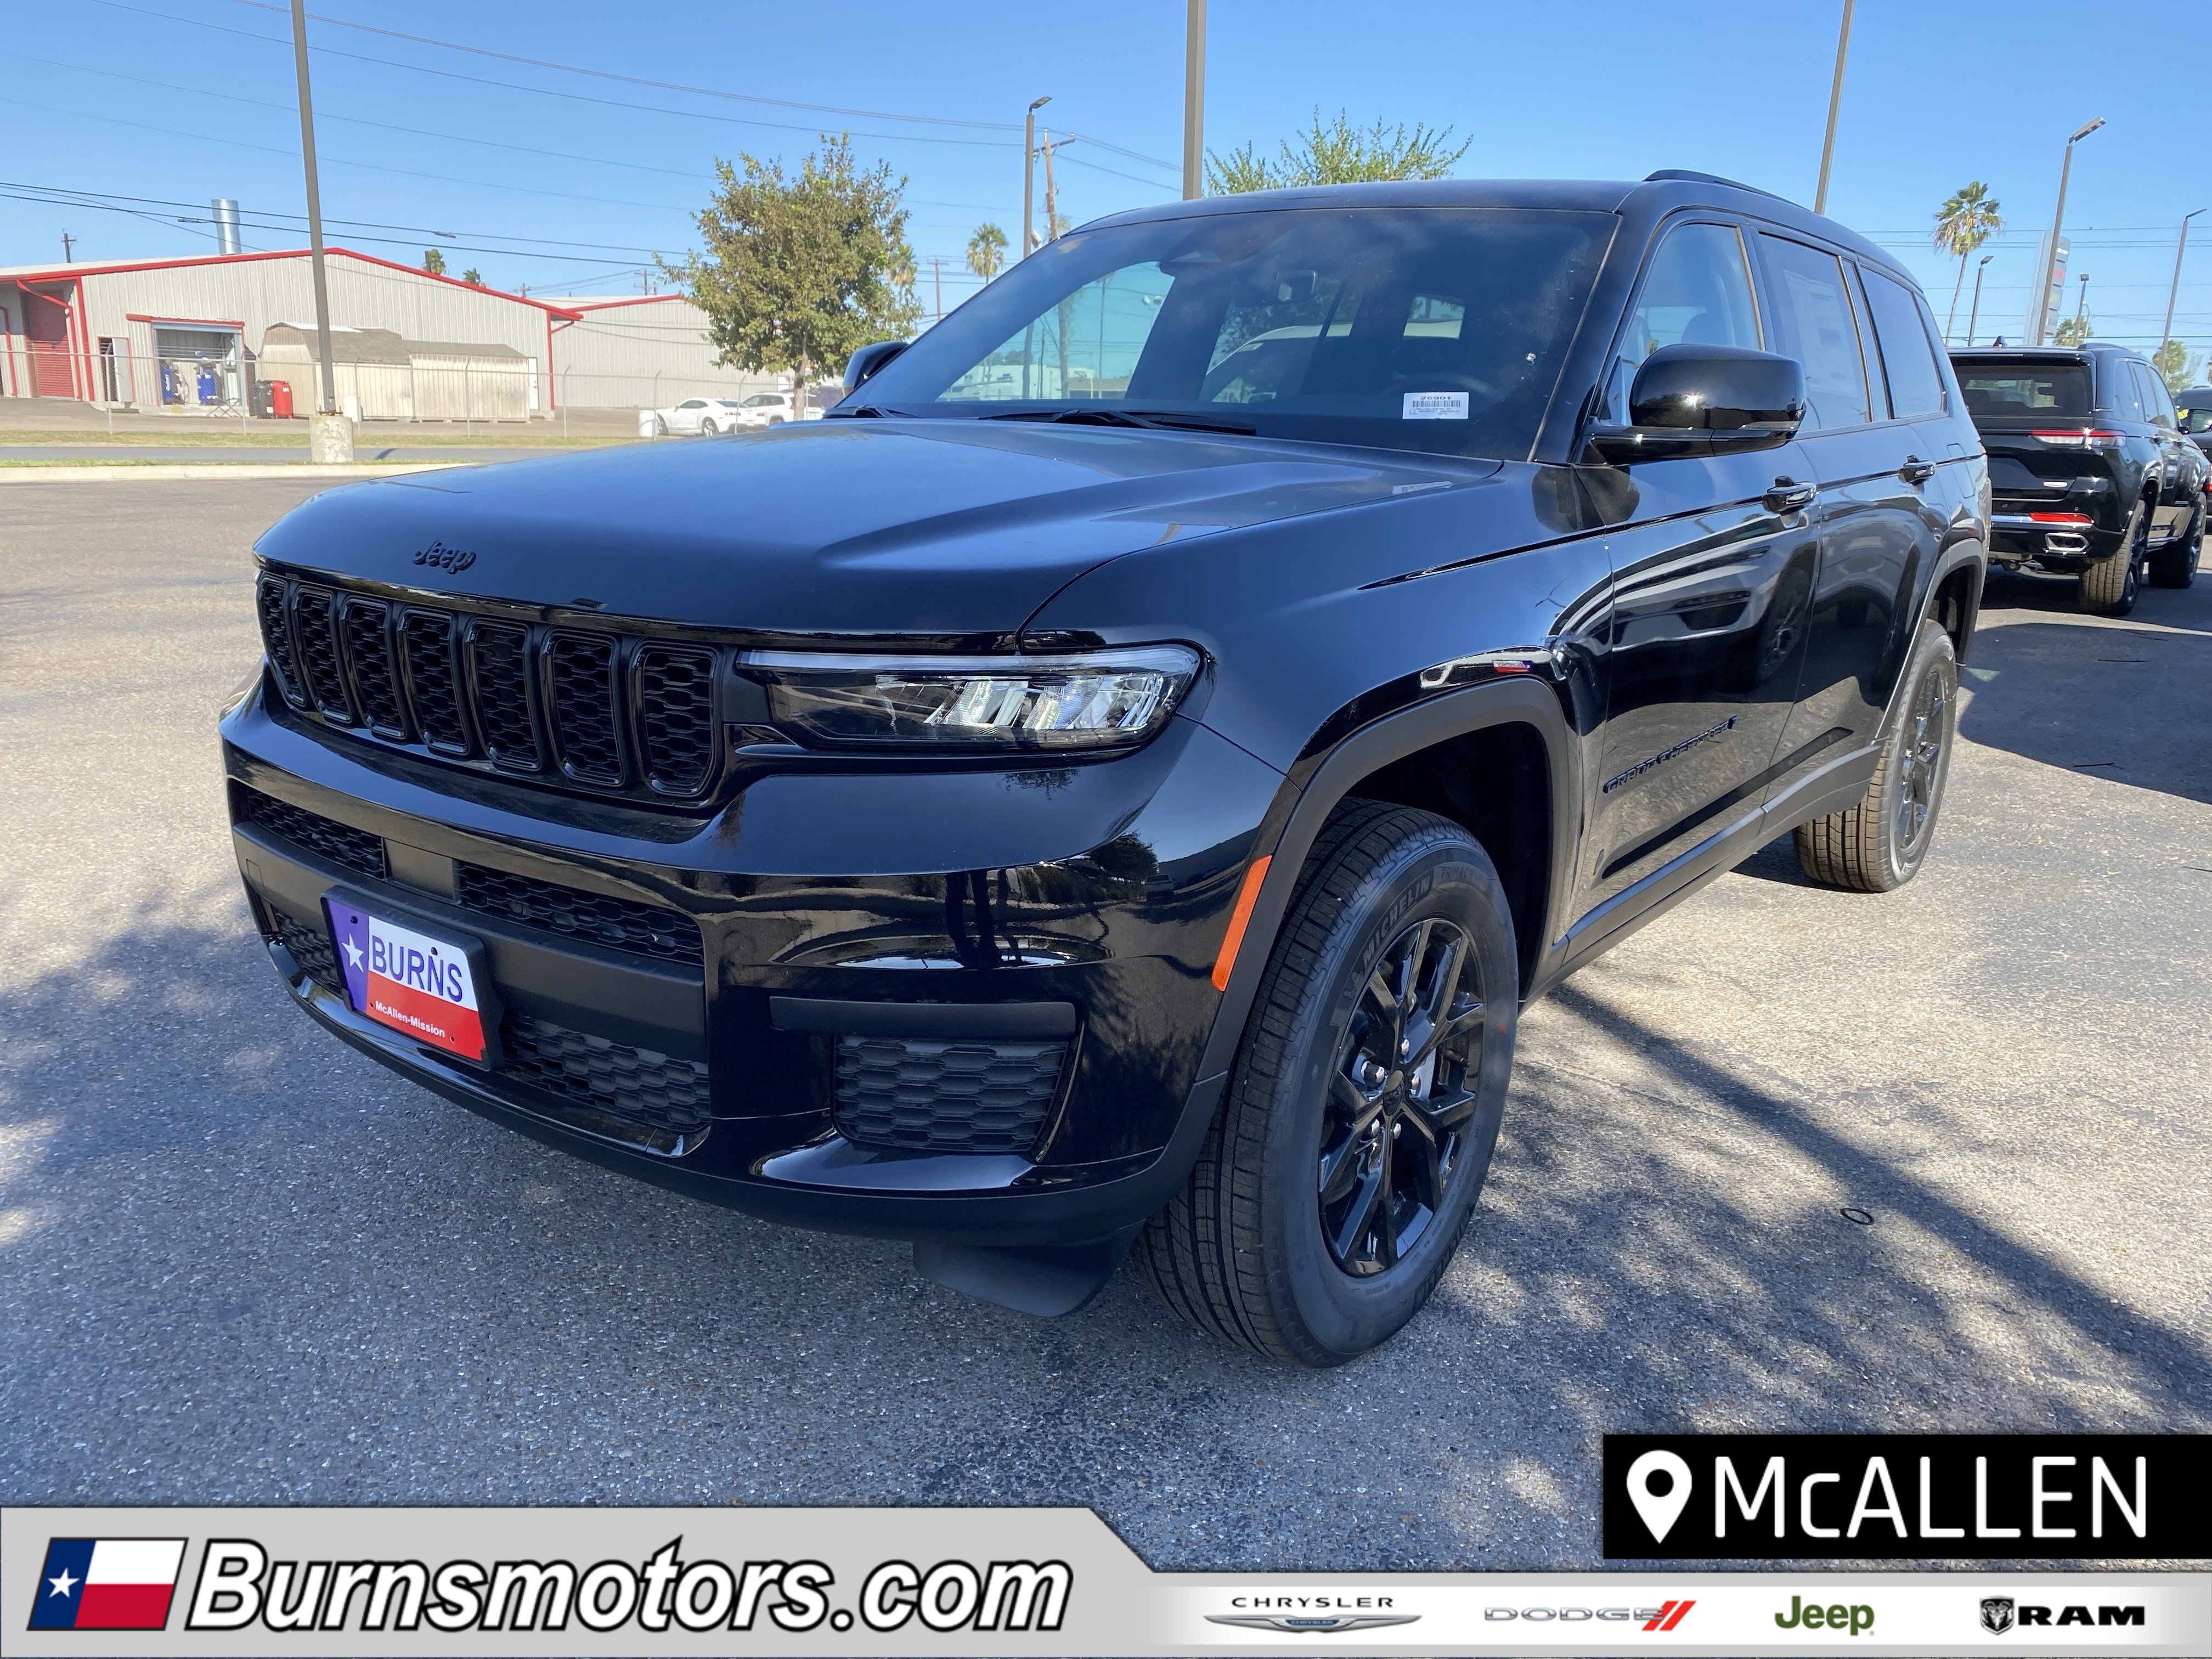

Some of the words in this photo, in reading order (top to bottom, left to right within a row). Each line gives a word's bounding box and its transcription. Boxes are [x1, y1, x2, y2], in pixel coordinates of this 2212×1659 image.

[412, 540, 477, 575] Jeep
[1363, 876, 1431, 967] MICHELIN
[372, 934, 462, 1002] BURNS
[375, 1000, 445, 1039] McAllen-Mission
